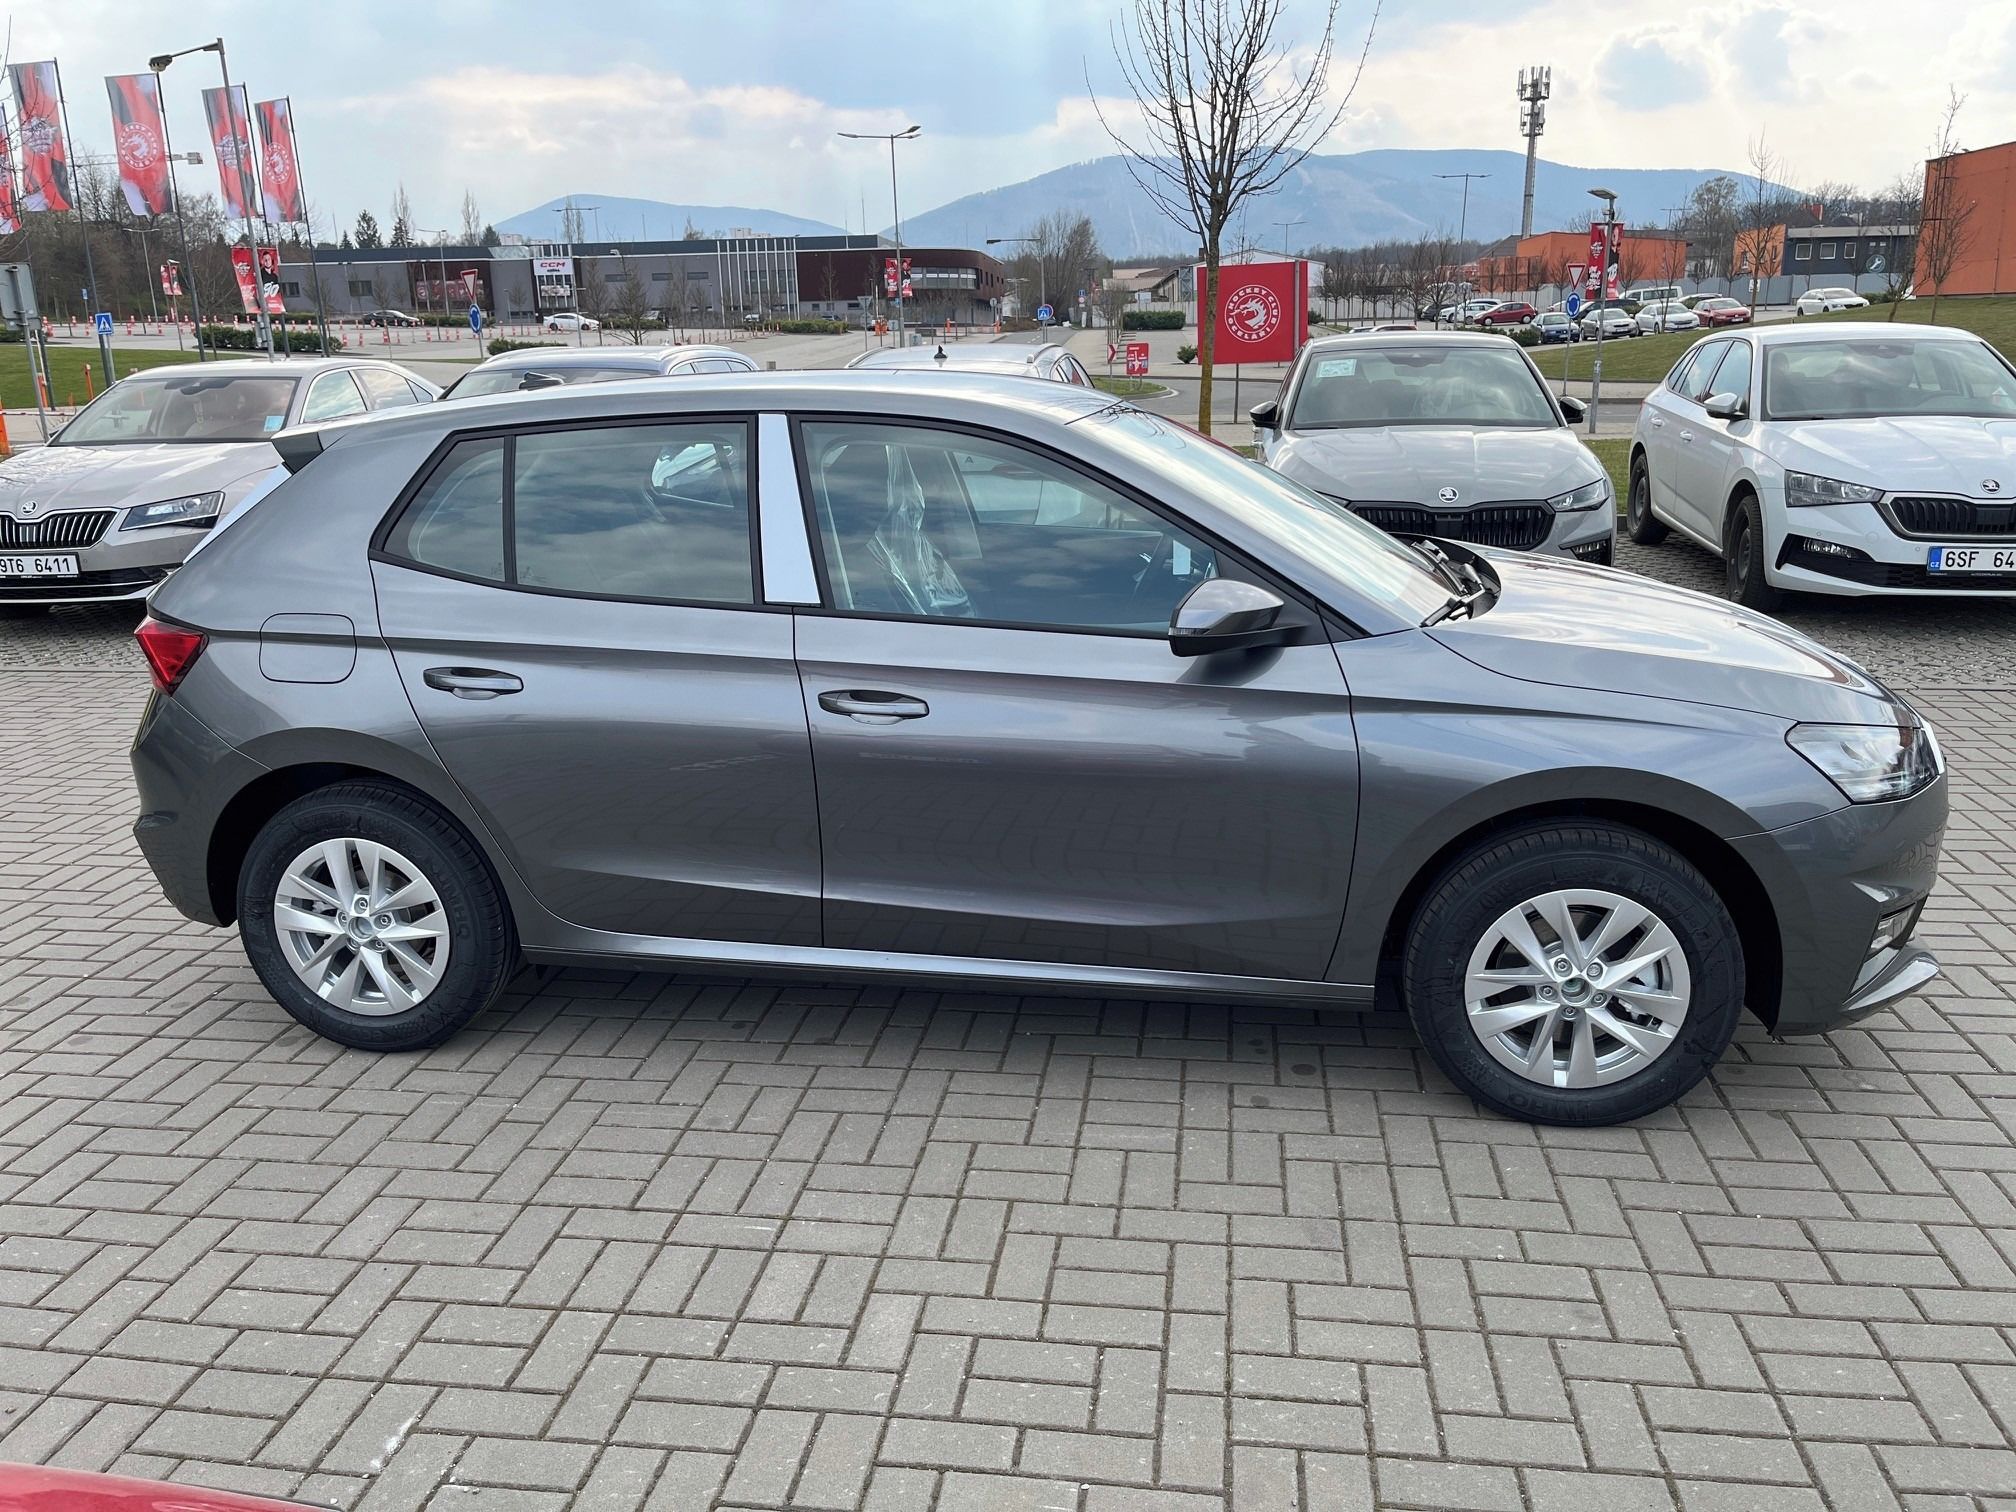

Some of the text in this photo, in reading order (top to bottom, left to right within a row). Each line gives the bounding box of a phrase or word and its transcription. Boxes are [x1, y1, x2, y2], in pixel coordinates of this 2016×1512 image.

[1228, 287, 1279, 325] HOCKEY CLUB
[0, 558, 70, 573] 9T6 6411
[1945, 551, 2015, 568] 6SF 64
